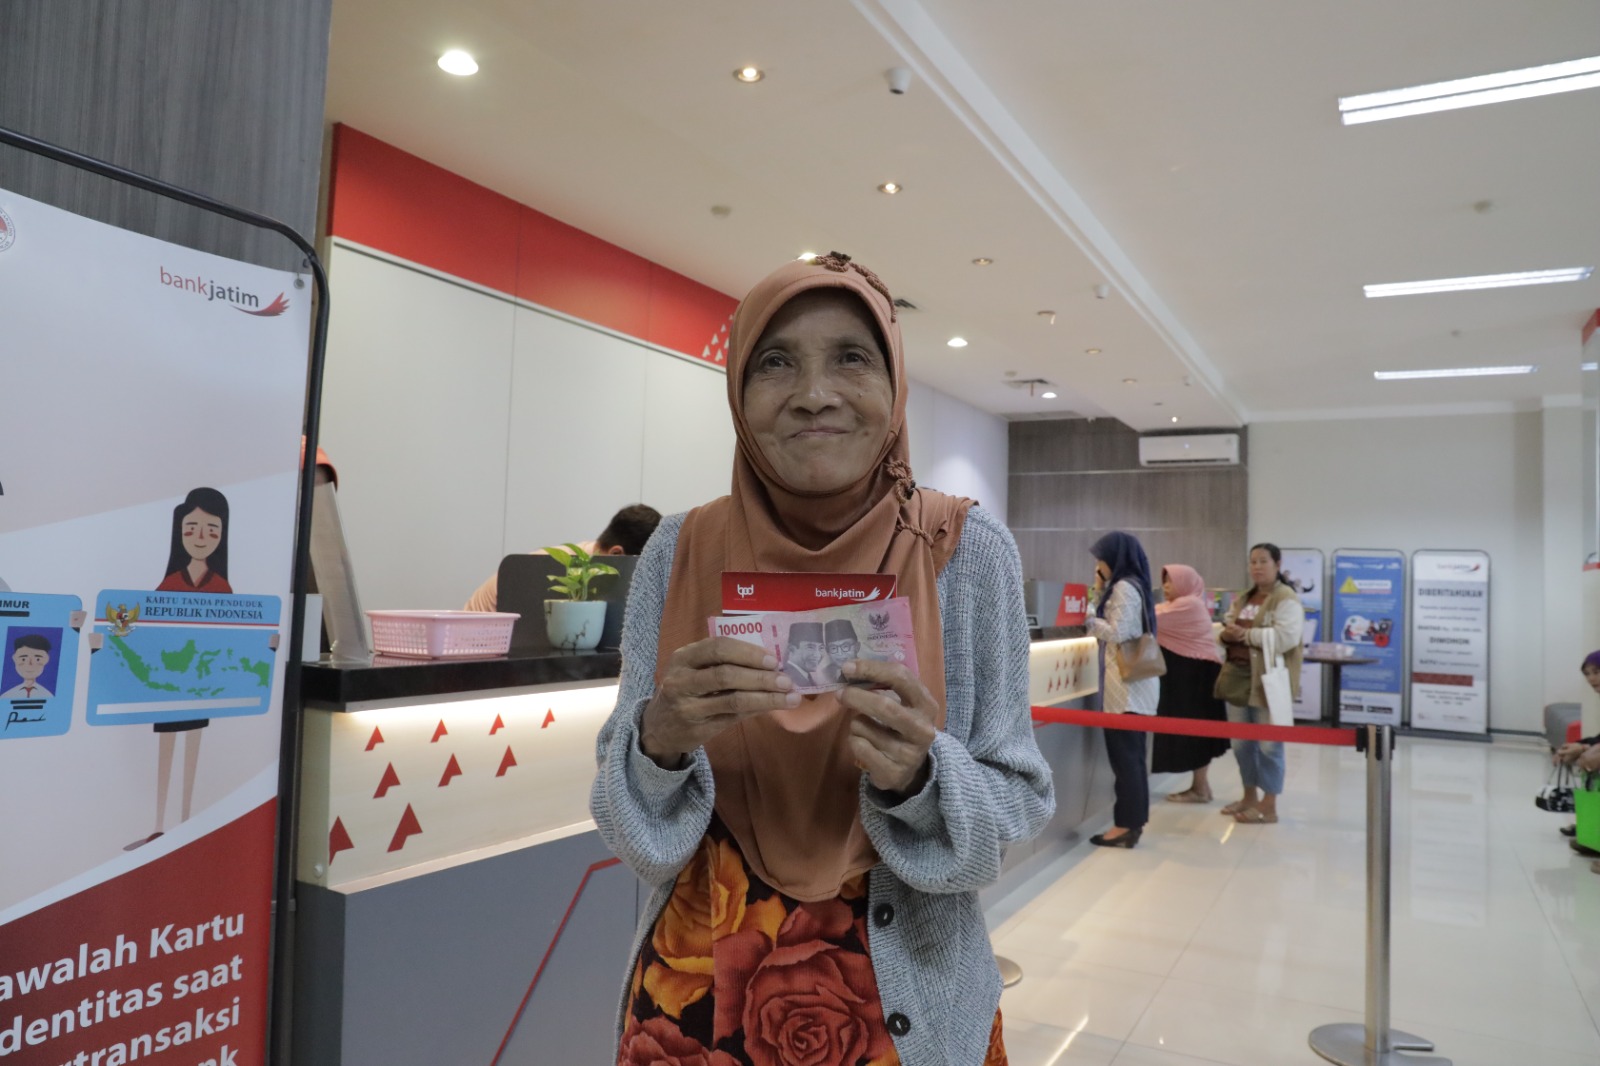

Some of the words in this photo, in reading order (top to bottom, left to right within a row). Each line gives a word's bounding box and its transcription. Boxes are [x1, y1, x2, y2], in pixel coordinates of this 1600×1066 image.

[159, 265, 260, 308] bankjatim
[815, 587, 865, 599] bankjatim
[145, 595, 178, 605] KARTU
[182, 597, 212, 607] TANDA
[214, 599, 264, 608] PENDUDUK
[145, 606, 202, 618] REPUBLIK
[204, 608, 263, 620] INDONESIA
[718, 621, 763, 636] 100000
[0, 934, 137, 1001] awalah
[150, 913, 244, 959] Kartu
[0, 990, 163, 1057] dentitas
[172, 954, 243, 1000] saat
